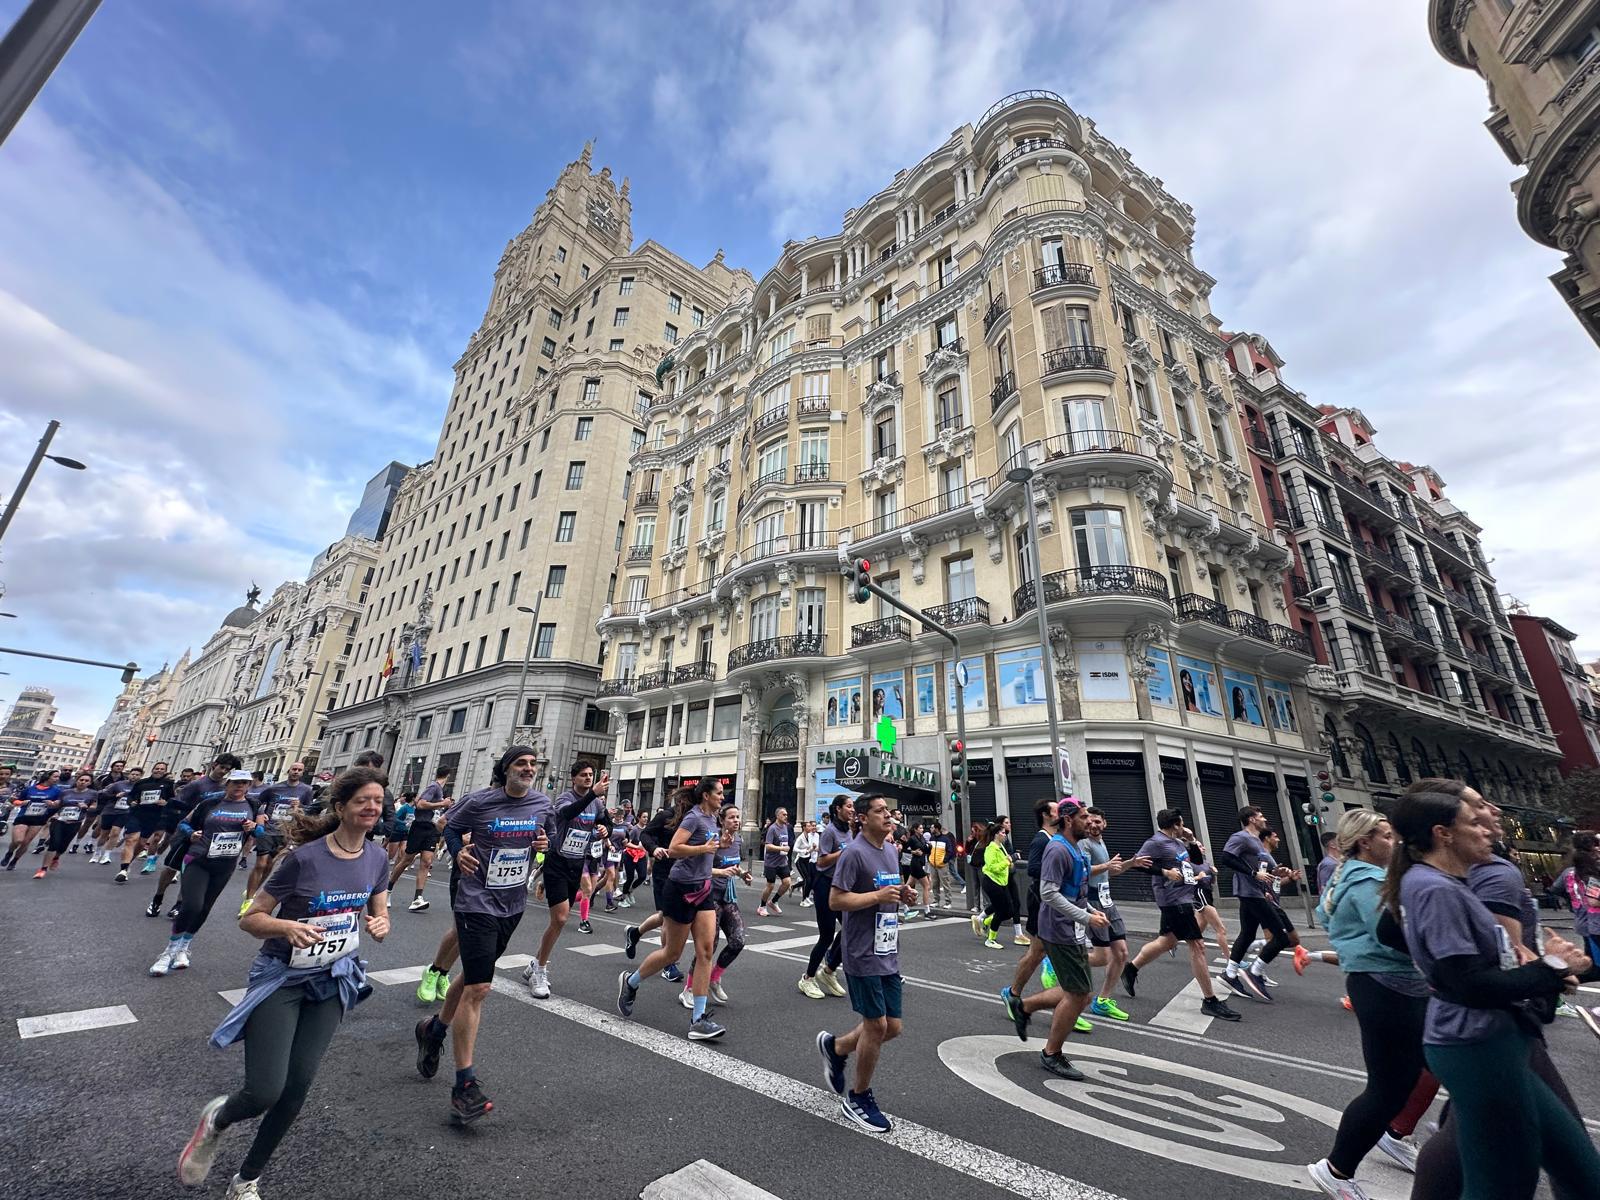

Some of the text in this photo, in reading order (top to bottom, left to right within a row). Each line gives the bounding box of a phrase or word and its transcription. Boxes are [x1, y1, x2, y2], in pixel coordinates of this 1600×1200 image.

[1092, 757, 1136, 767] aristocrazy
[879, 761, 936, 786] FARMACIA
[901, 804, 934, 813] FARMACIA
[216, 843, 237, 851] 2595
[497, 865, 523, 878] 1753
[308, 938, 348, 957] 1757
